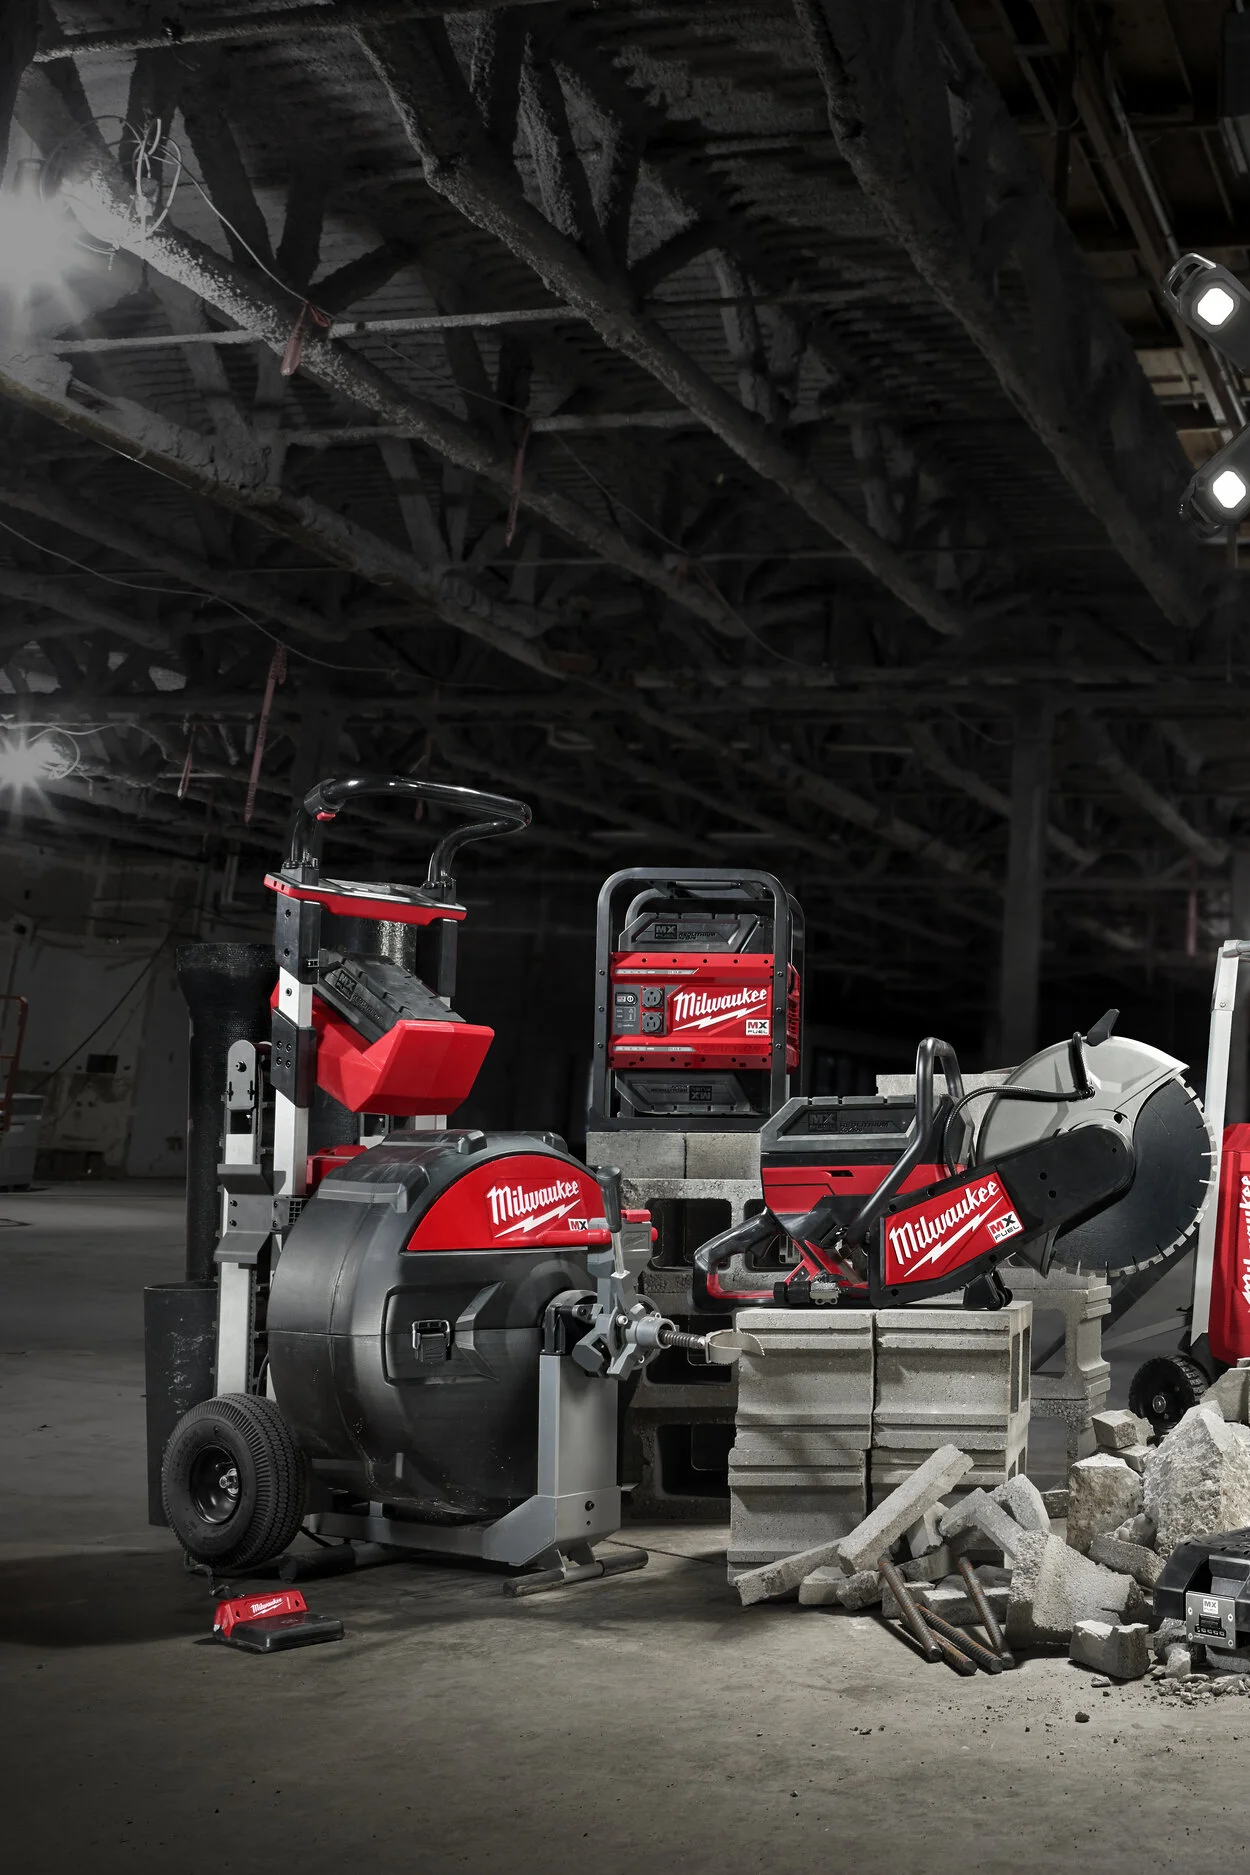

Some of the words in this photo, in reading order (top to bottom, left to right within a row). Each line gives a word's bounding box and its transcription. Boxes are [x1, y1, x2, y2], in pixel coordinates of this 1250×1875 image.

[655, 925, 676, 934] MX
[673, 987, 767, 1022] Milwaukee
[747, 1021, 768, 1029] MX
[487, 1180, 580, 1226] Milwaukee
[570, 1220, 588, 1230] MX
[889, 1180, 1000, 1265] Milwaukee
[989, 1213, 1016, 1235] MX
[994, 1225, 1020, 1241] FUEL
[250, 1597, 282, 1613] Milwaukee
[1204, 1600, 1217, 1608] MX
